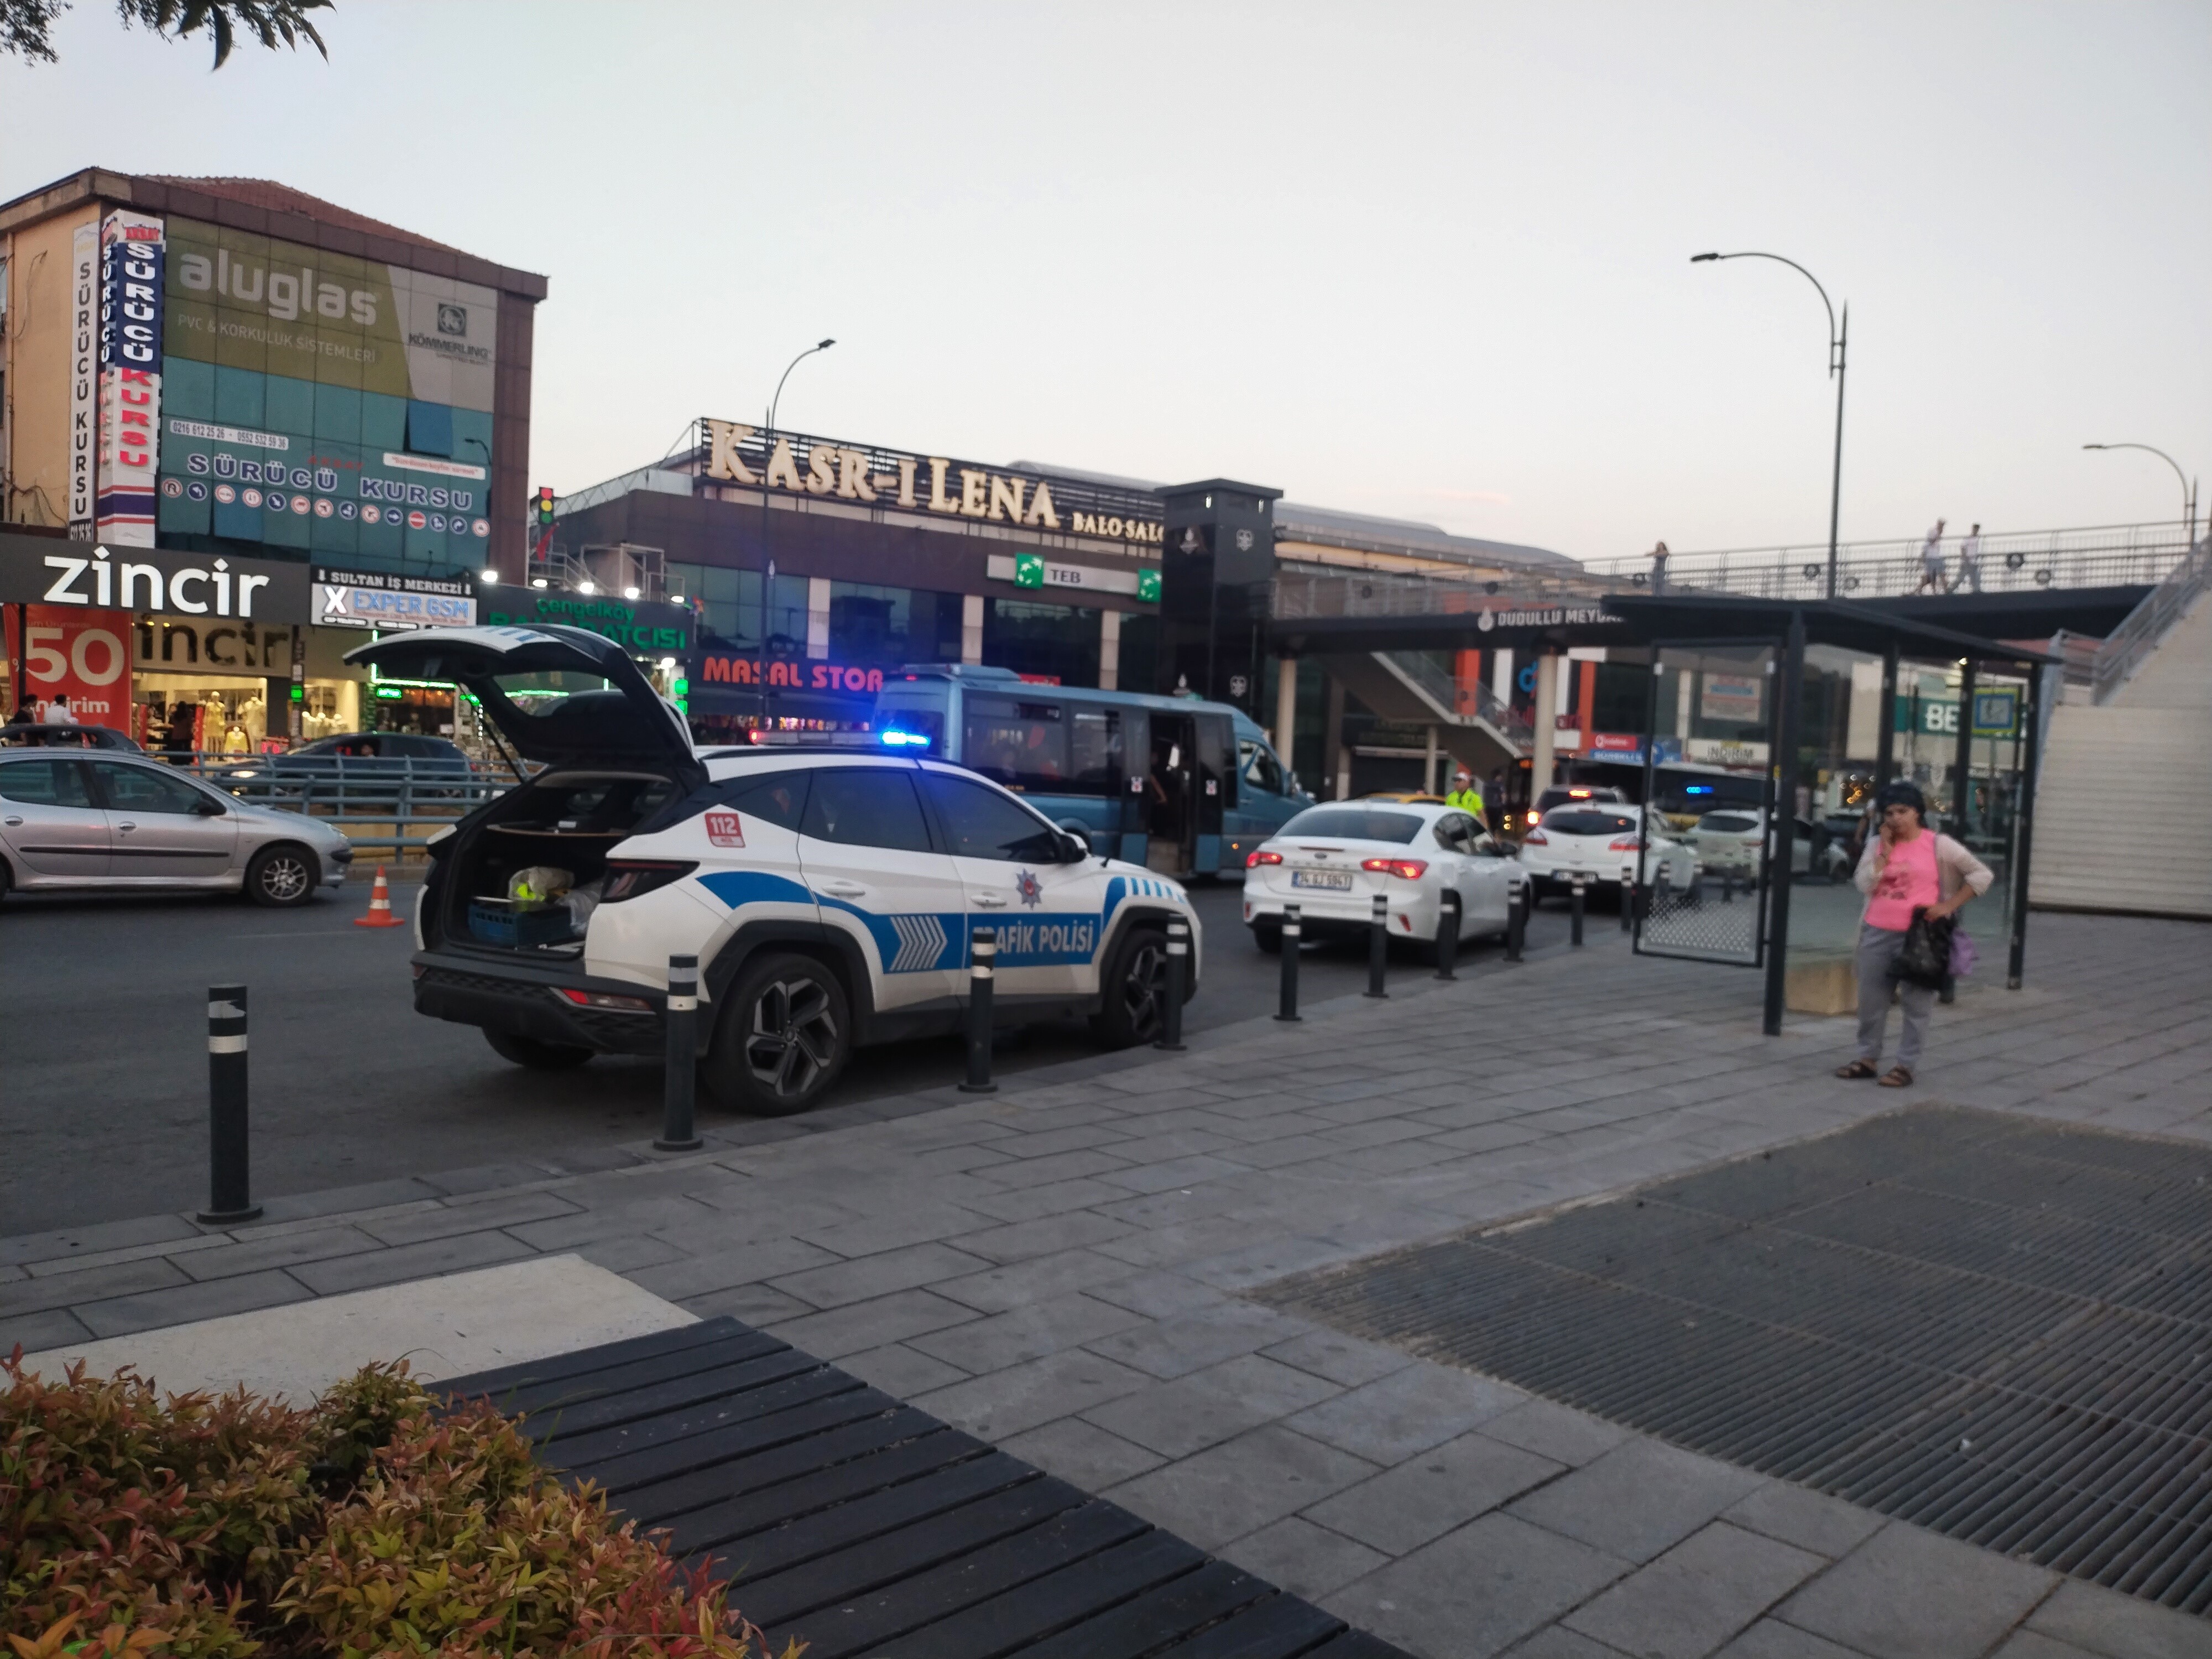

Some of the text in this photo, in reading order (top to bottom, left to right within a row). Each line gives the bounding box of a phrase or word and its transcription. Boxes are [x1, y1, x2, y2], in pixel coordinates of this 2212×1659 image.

[123, 243, 155, 362] SÜRÜCÜ
[180, 248, 377, 326] aluglas
[76, 261, 91, 401] SÜRÜCÜ
[178, 314, 202, 330] PVC
[219, 322, 294, 348] KORKULUK
[119, 367, 152, 467] KURSU
[75, 411, 88, 515] KURSU
[187, 453, 472, 510] SÜRÜCÜ KURSU
[928, 457, 1061, 528] LENA
[1072, 510, 1123, 536] BALO
[44, 545, 270, 618] zincir
[331, 571, 384, 587] SULTAN
[404, 578, 462, 594] MERKEZİ
[1050, 569, 1081, 583] TEB
[353, 590, 422, 614] EXPER
[427, 597, 469, 618] GSM
[1498, 609, 1562, 627] DUDULLU
[710, 816, 738, 834] 112
[1039, 919, 1094, 953] POLİSİ
